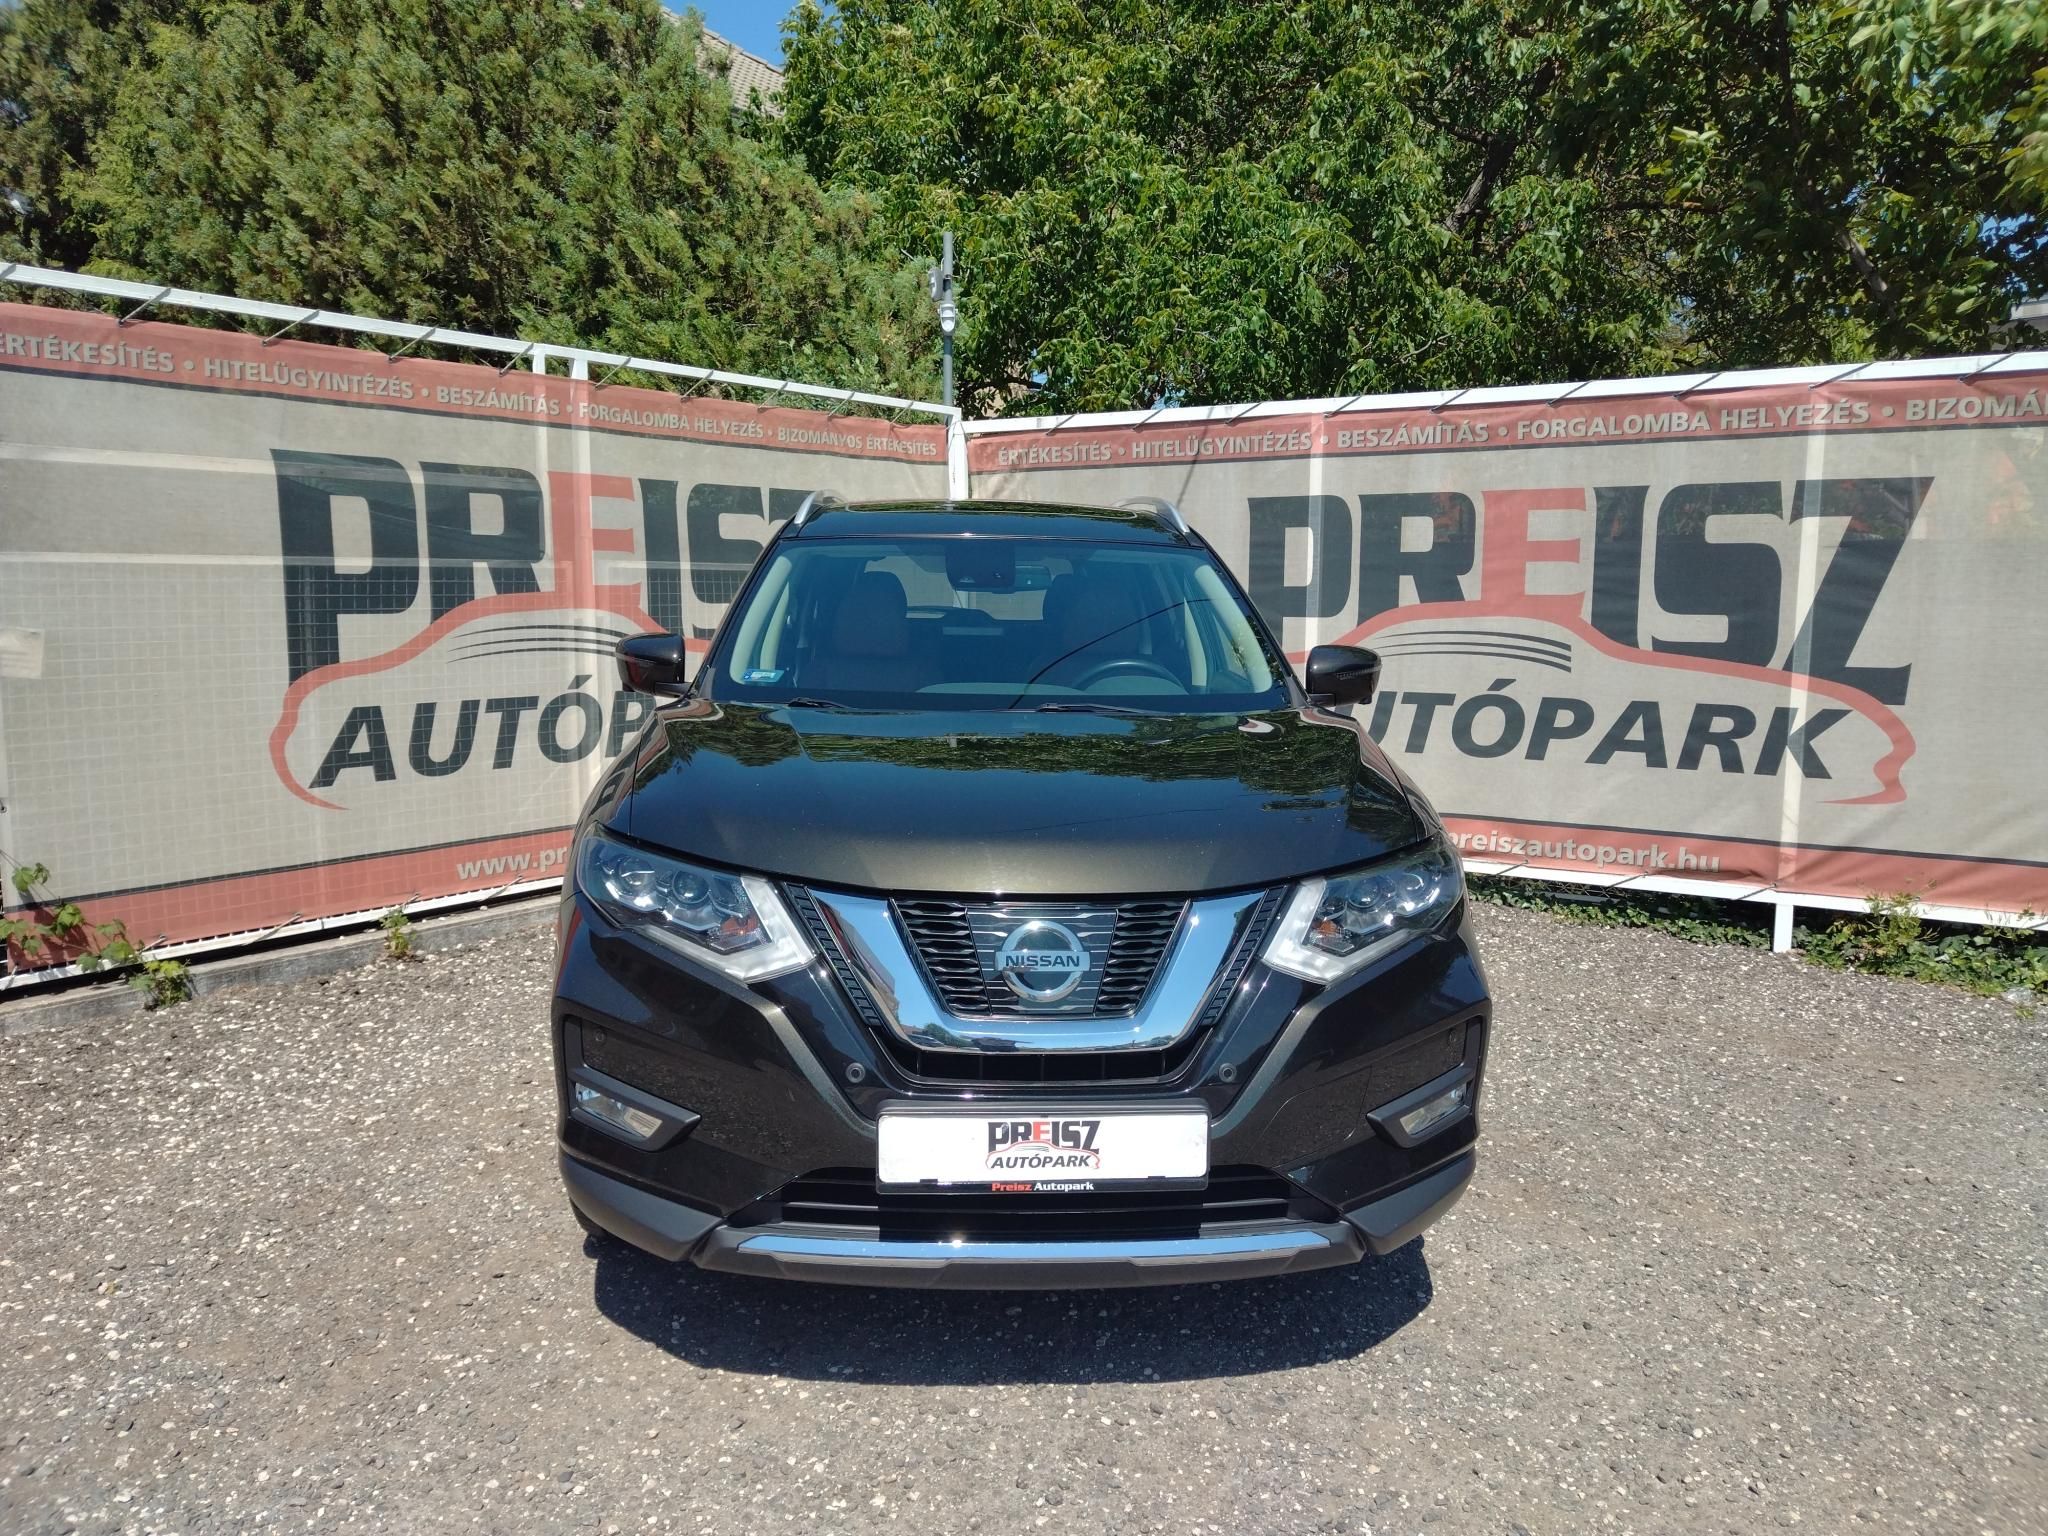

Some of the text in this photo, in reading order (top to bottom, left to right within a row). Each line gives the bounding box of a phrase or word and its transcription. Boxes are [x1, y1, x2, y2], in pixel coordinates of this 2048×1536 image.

[204, 357, 414, 400] HITELÜGYINTÉZÉS
[436, 384, 561, 416] BESZÁMÍTÁS
[578, 402, 690, 430] FORGALOMBA
[694, 416, 764, 438] HELYEZÉS
[777, 426, 863, 449] BIZOMÁNYOS
[998, 388, 2048, 466] ÉRTÉKESÍTÉS HITELÜGYINTÉZÉS BESZÁMÍTÁS FORGALOMBA HELYEZÉS BIZOMÁ
[270, 448, 816, 687] PREIS
[1247, 475, 1935, 706] PREISZ
[308, 674, 656, 789] AUTÓP
[456, 846, 567, 880] www.pr
[1005, 954, 1080, 967] NISSAN
[987, 1120, 1101, 1154] PREISZ
[990, 1154, 1092, 1170] AUTÓPARK
[991, 1181, 1095, 1192] Preisz Autopark
